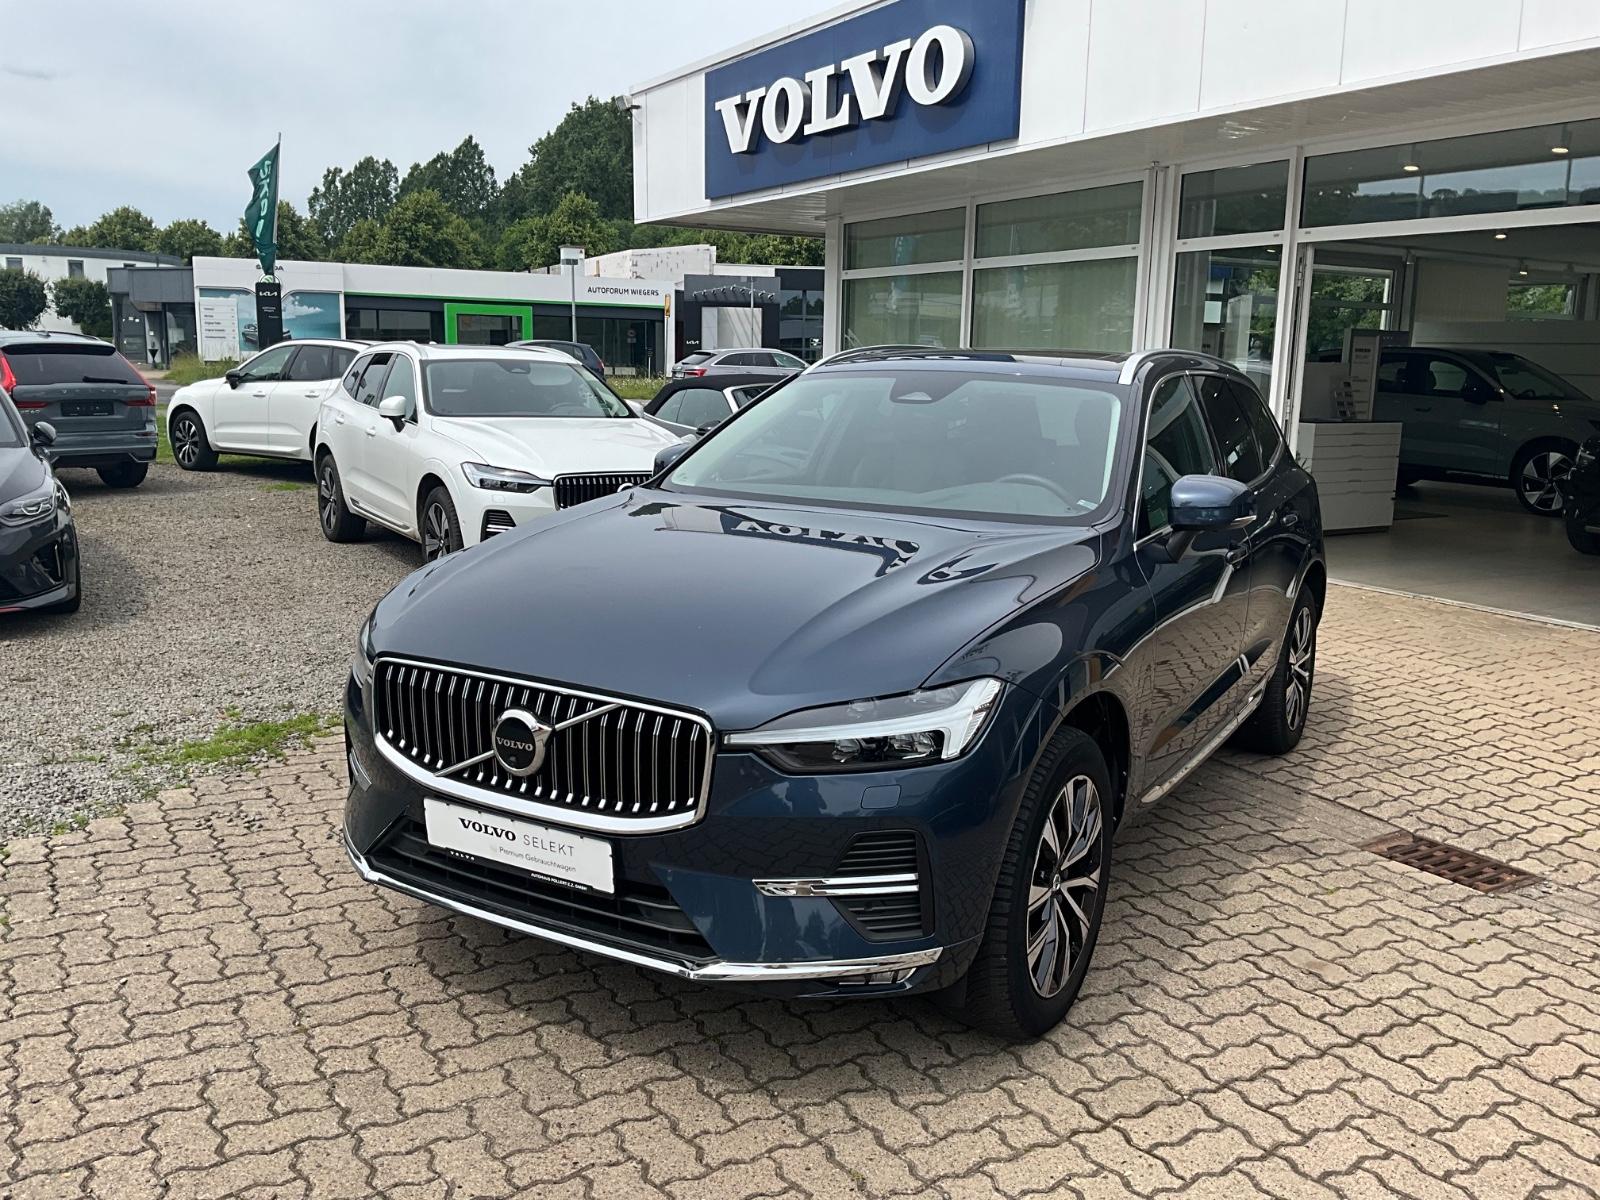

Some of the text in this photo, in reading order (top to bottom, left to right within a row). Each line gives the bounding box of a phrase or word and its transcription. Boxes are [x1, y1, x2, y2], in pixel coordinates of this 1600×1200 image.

[714, 24, 975, 154] VOLVO
[587, 286, 659, 296] AUTOFORUM WIEGERS
[496, 736, 534, 752] VOLVO
[458, 816, 575, 857] VOLVO SELEKT
[449, 850, 475, 861] VOLVO
[499, 846, 577, 873] Premium Gebrauchtwagen
